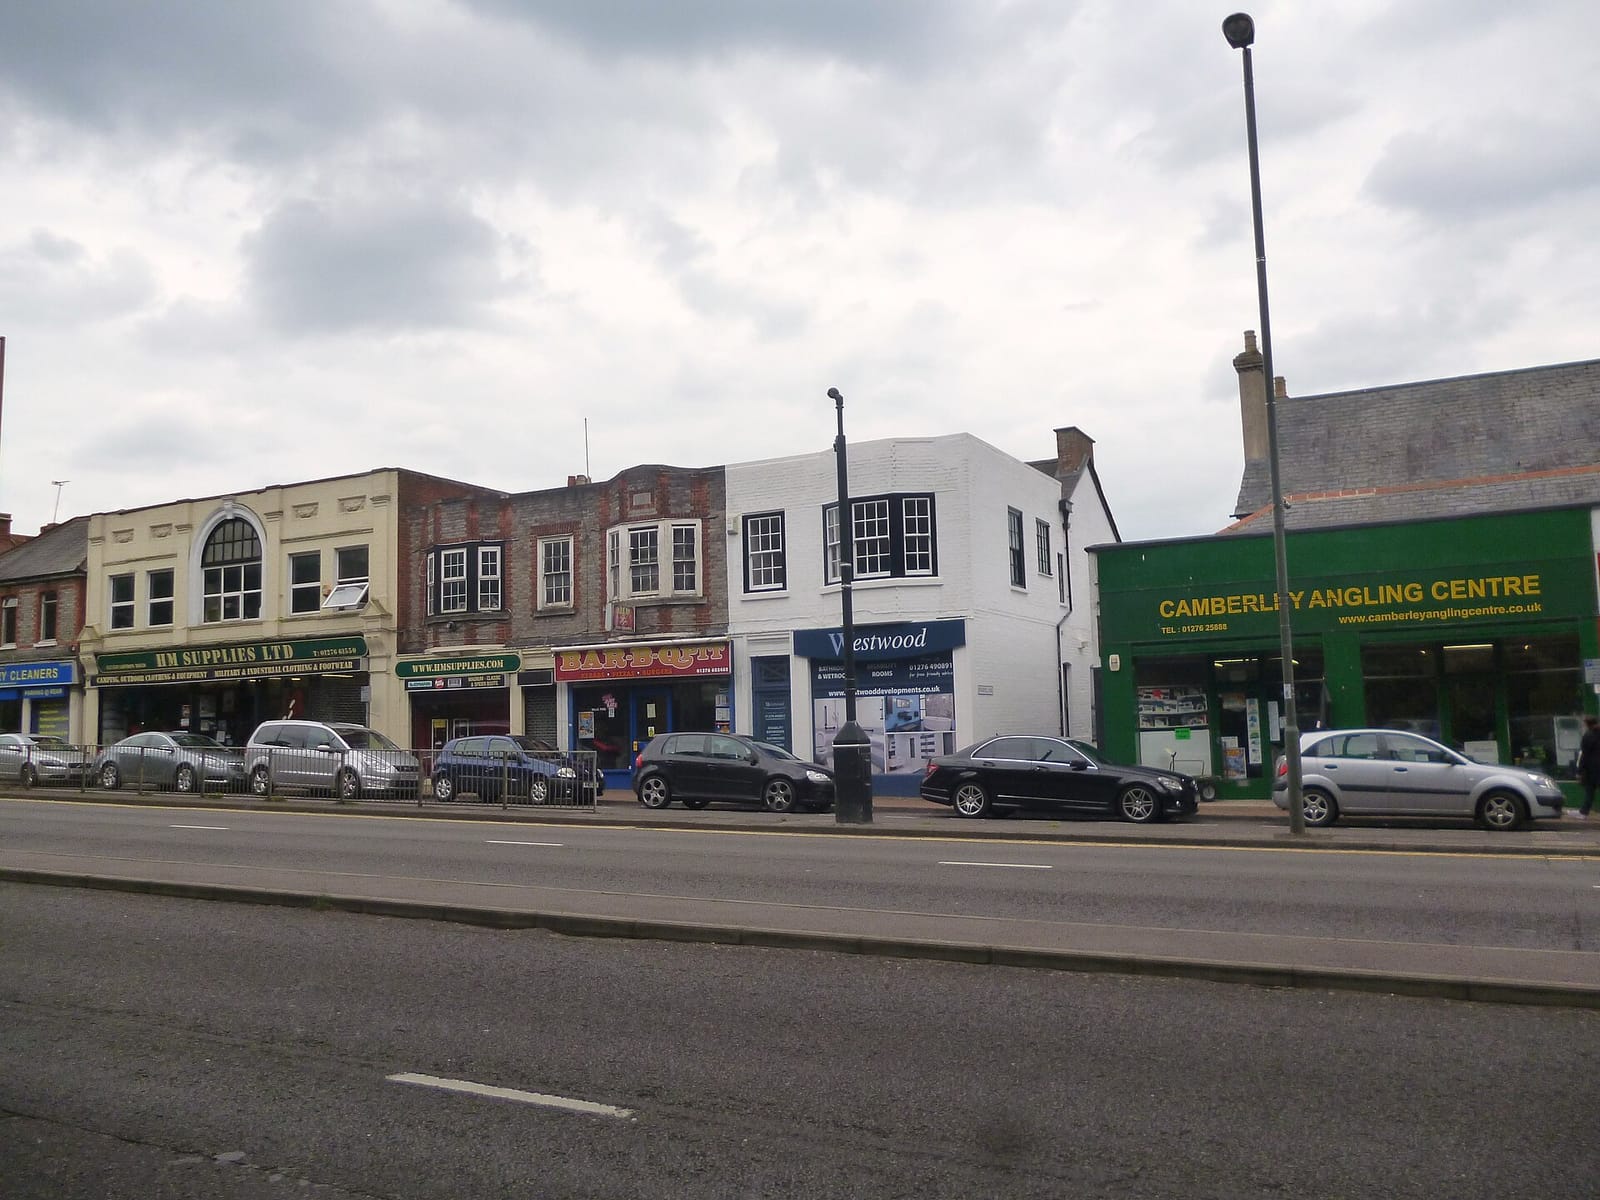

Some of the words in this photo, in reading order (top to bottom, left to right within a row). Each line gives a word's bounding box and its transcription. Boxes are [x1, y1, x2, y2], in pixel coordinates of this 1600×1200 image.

[1308, 582, 1424, 609] ANGLING
[1431, 575, 1541, 600] CENTRE
[1338, 602, 1542, 624] www.camberleyanglingcentre.co.uk
[1182, 625, 1204, 633] 01276
[828, 627, 927, 656] Westwood
[156, 652, 179, 667] HM
[182, 646, 256, 665] SUPPLIES
[262, 644, 294, 660] LTD
[10, 667, 58, 680] CLEANERS
[145, 673, 171, 681] CLOTHING
[176, 671, 208, 679] EQUIPMENT
[215, 669, 240, 678] MILITARY
[247, 666, 281, 676] INDUSTRIAL
[282, 664, 312, 673] CLOTHING
[319, 661, 353, 670] FOOTWEAR
[412, 660, 504, 673] WWW.HMSUPPLIES.COM
[871, 670, 894, 678] ROOMS
[929, 662, 953, 670] 490891
